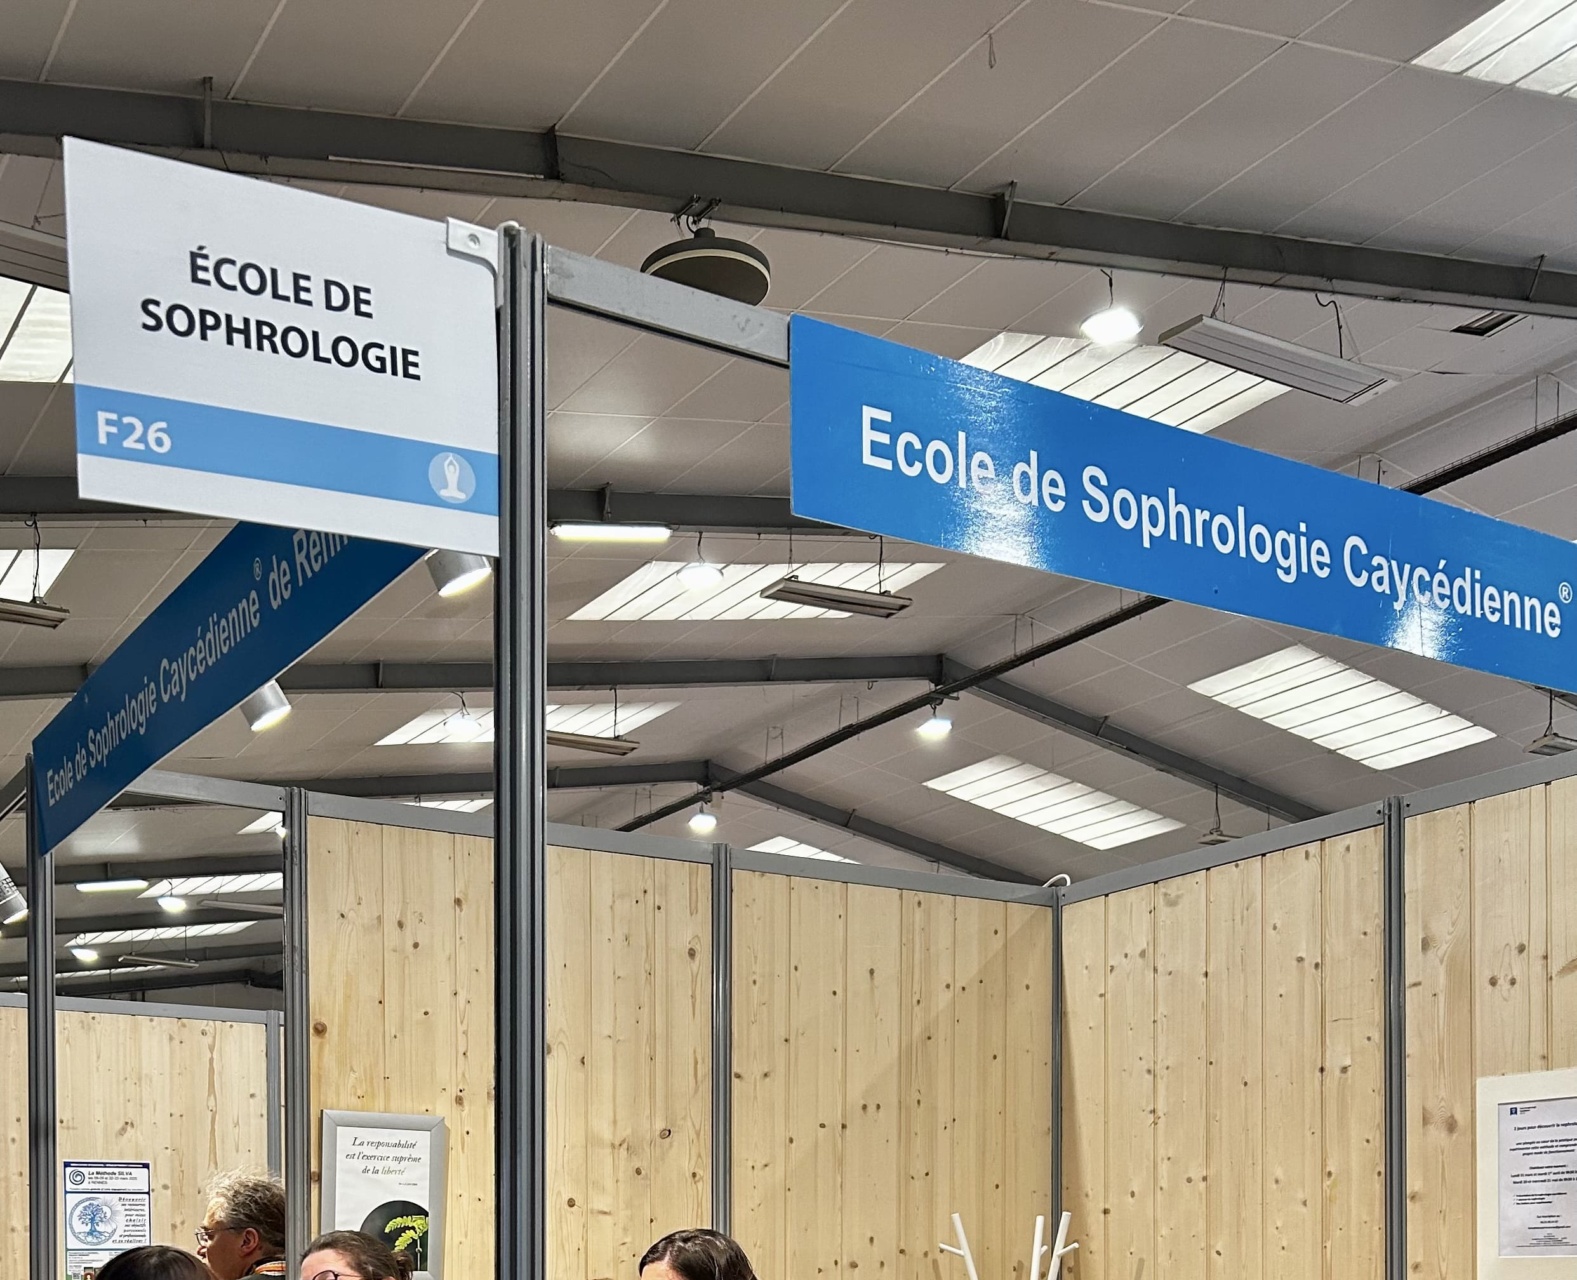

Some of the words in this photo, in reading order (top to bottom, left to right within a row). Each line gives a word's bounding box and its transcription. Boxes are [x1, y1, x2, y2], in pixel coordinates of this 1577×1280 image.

[189, 245, 313, 307] ÉCOLE
[323, 278, 374, 319] DE
[140, 298, 422, 381] SOPHROLOGIE
[96, 410, 172, 454] F26
[861, 404, 997, 491] Ecole
[1013, 449, 1067, 513] de
[1082, 464, 1332, 583] Sophrologie
[46, 758, 74, 808] Ecole
[74, 744, 88, 781] de
[87, 681, 158, 769] Sophrologie
[268, 554, 292, 610] de
[345, 1152, 356, 1160] est
[391, 1153, 422, 1164] suprême
[351, 1136, 365, 1147] La
[366, 1139, 418, 1150] responsabilité
[361, 1165, 371, 1174] de
[371, 1165, 380, 1175] la
[380, 1166, 407, 1176] liberté
